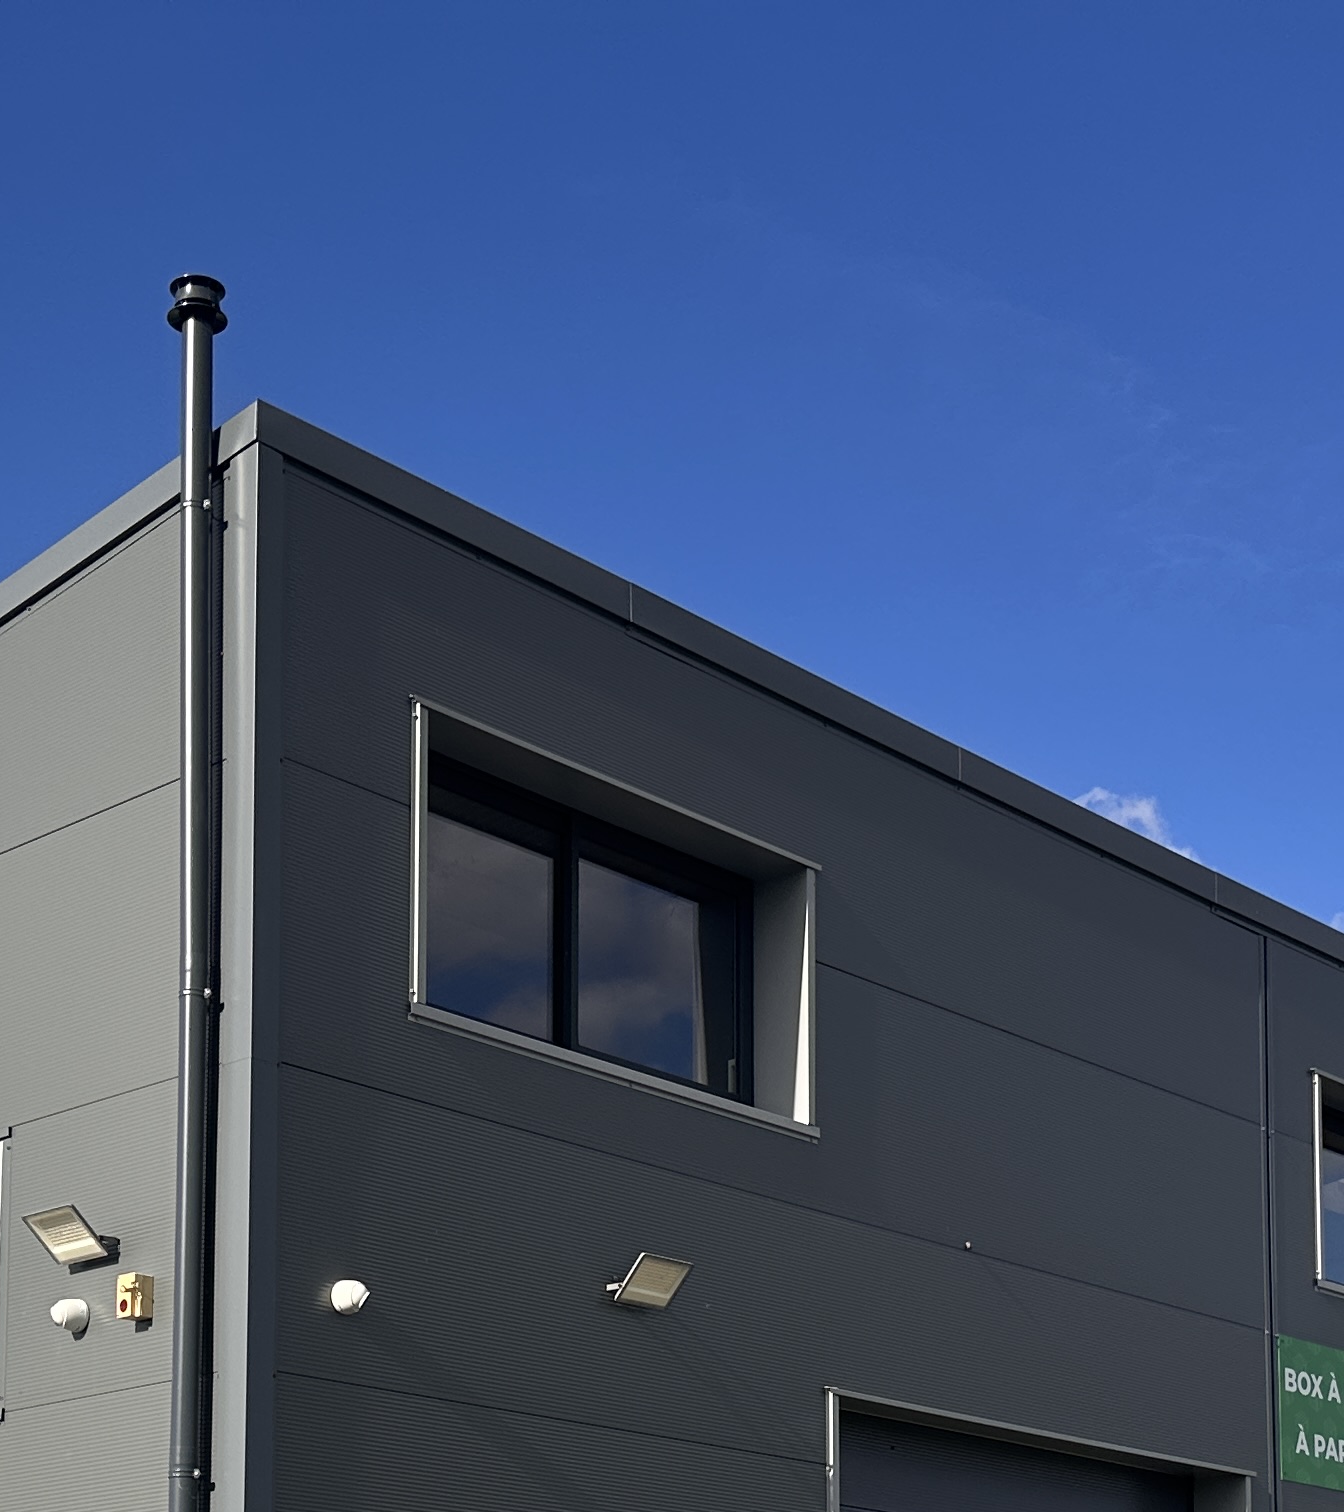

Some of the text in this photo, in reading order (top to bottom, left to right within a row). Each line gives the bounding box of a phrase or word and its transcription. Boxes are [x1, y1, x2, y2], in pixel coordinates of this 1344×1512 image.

[1284, 1367, 1324, 1399] BOX
[1327, 1372, 1341, 1404] À
[1296, 1424, 1309, 1456] À
